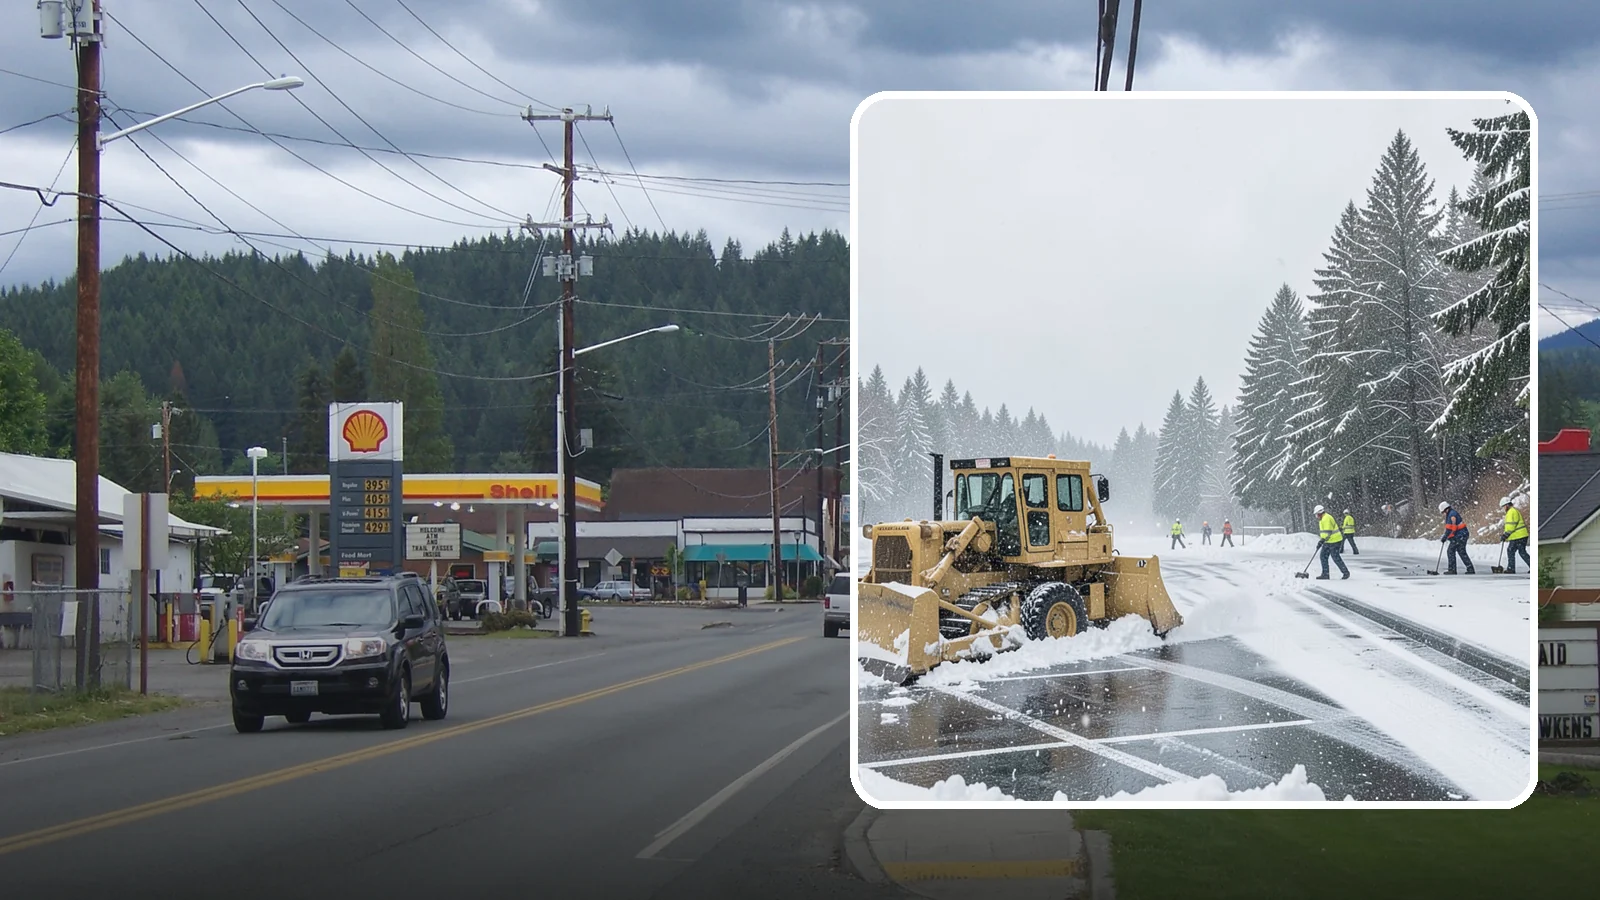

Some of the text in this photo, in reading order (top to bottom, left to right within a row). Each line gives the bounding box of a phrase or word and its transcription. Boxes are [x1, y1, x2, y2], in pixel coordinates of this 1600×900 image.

[365, 480, 383, 490] 395
[490, 484, 547, 499] Shell
[365, 494, 383, 504] 405
[365, 508, 383, 518] 415
[365, 522, 383, 532] 429
